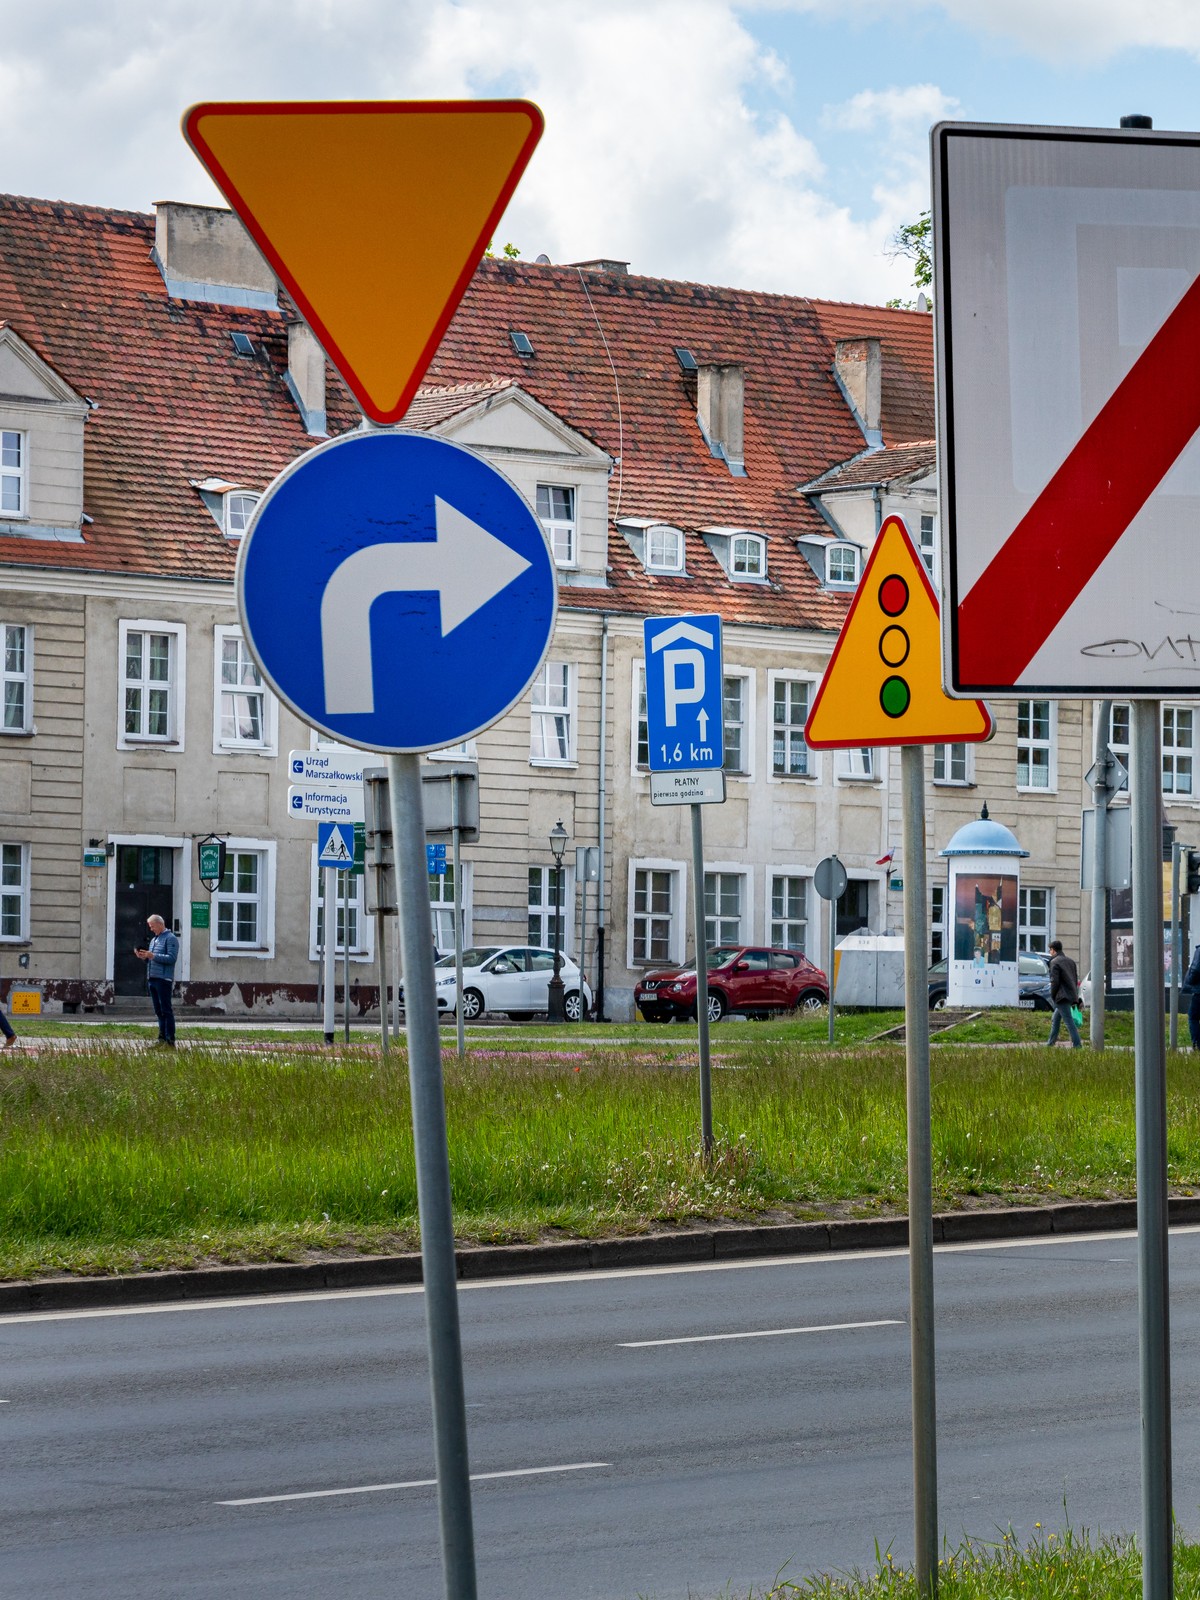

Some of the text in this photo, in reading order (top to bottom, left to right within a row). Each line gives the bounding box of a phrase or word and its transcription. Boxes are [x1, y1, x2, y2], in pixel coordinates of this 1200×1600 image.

[663, 648, 705, 727] P
[660, 742, 714, 765] 1,6 km
[305, 757, 329, 768] Urząd
[305, 769, 363, 781] Marszałkowski
[674, 777, 700, 786] PŁATNY
[305, 792, 348, 804] Informacja
[653, 790, 679, 800] pierwsza
[679, 789, 704, 798] godzina
[305, 805, 351, 816] Turystyczna
